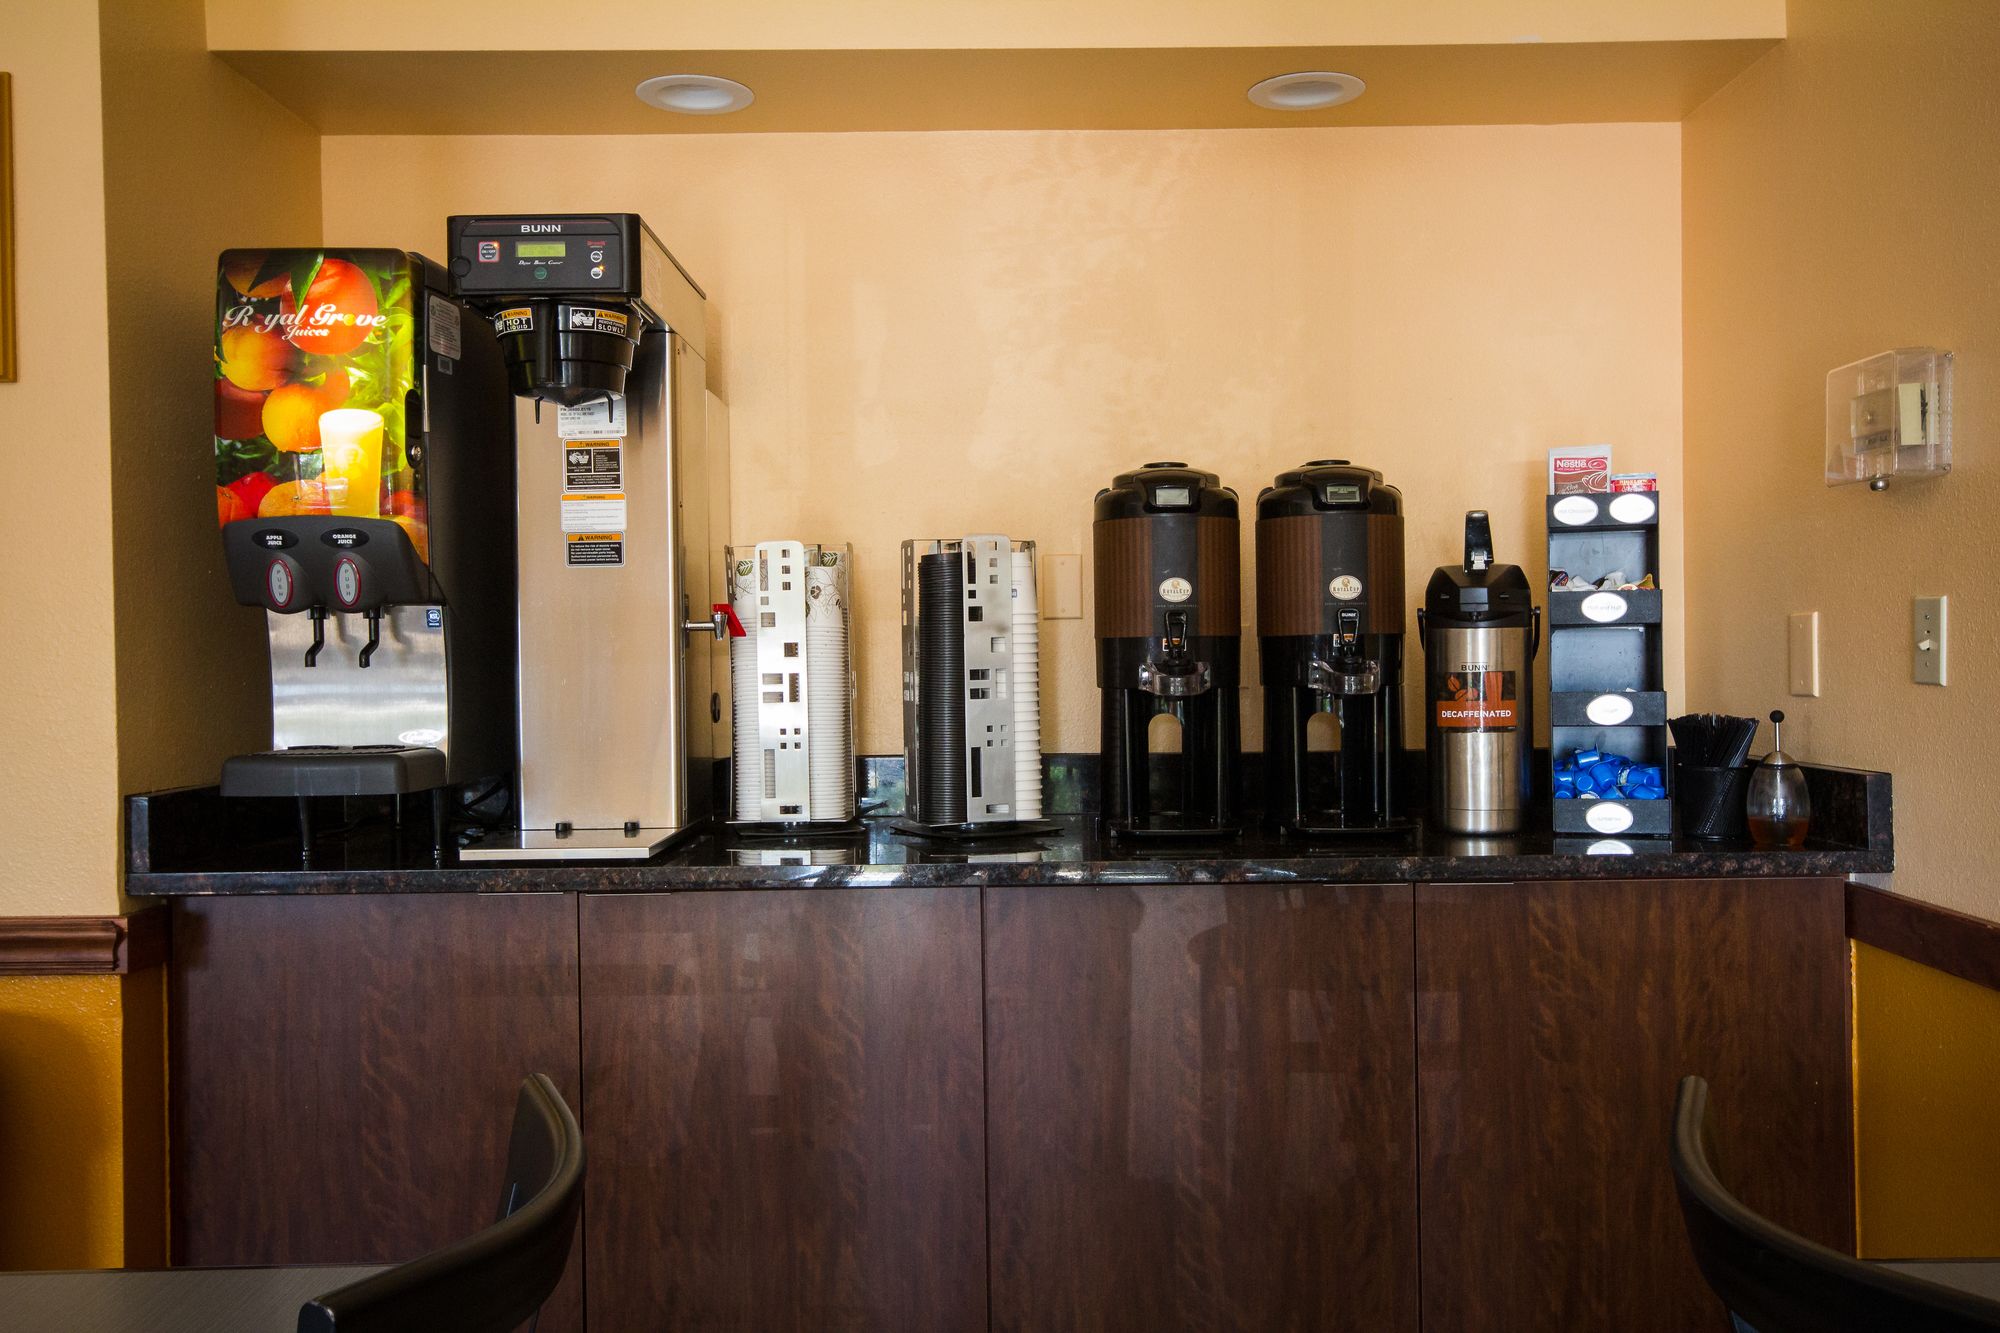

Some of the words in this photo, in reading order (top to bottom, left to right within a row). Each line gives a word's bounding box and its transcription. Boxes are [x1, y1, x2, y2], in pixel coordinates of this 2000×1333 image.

[521, 225, 561, 233] BUNN
[309, 302, 389, 328] Grove
[603, 312, 625, 322] WARNING
[506, 317, 527, 326] HOT
[506, 323, 528, 331] LIQUID
[597, 324, 625, 334] SLOWLY
[282, 325, 330, 341] Juices
[1441, 709, 1512, 718] DECAFFENATED
